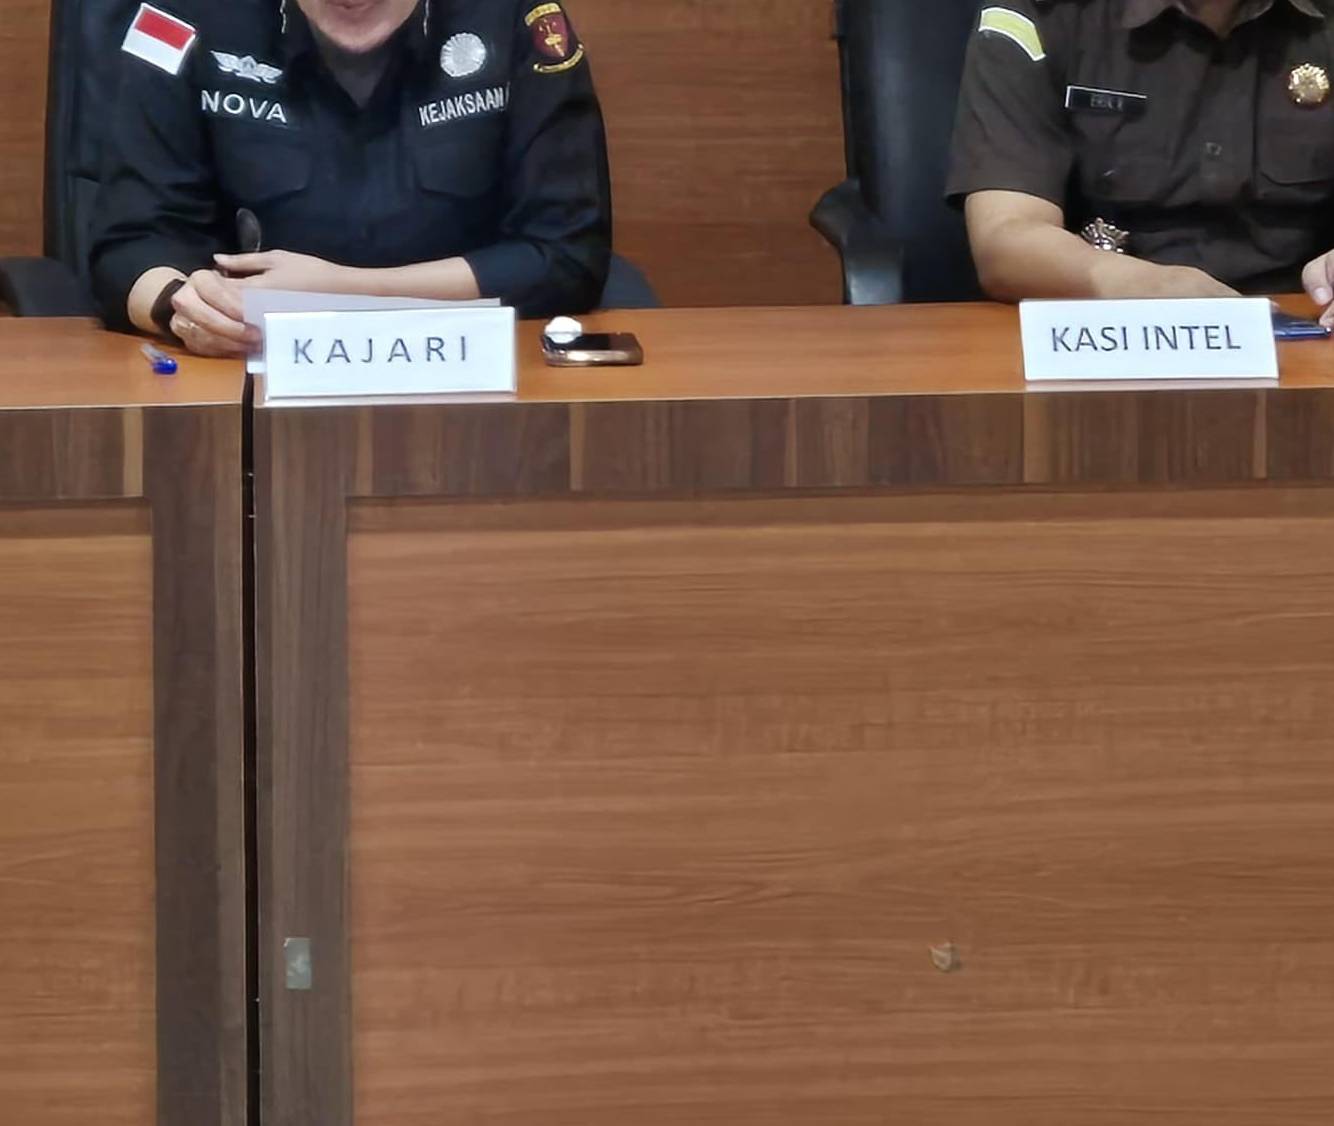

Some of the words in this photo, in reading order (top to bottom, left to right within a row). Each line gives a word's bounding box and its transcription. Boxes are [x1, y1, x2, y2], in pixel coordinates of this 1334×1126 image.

[200, 88, 288, 125] NOVA
[418, 86, 505, 127] KEJAKSAAN
[292, 334, 469, 366] KAJARI
[1050, 325, 1131, 354] KASI
[1141, 323, 1242, 353] INTEL
